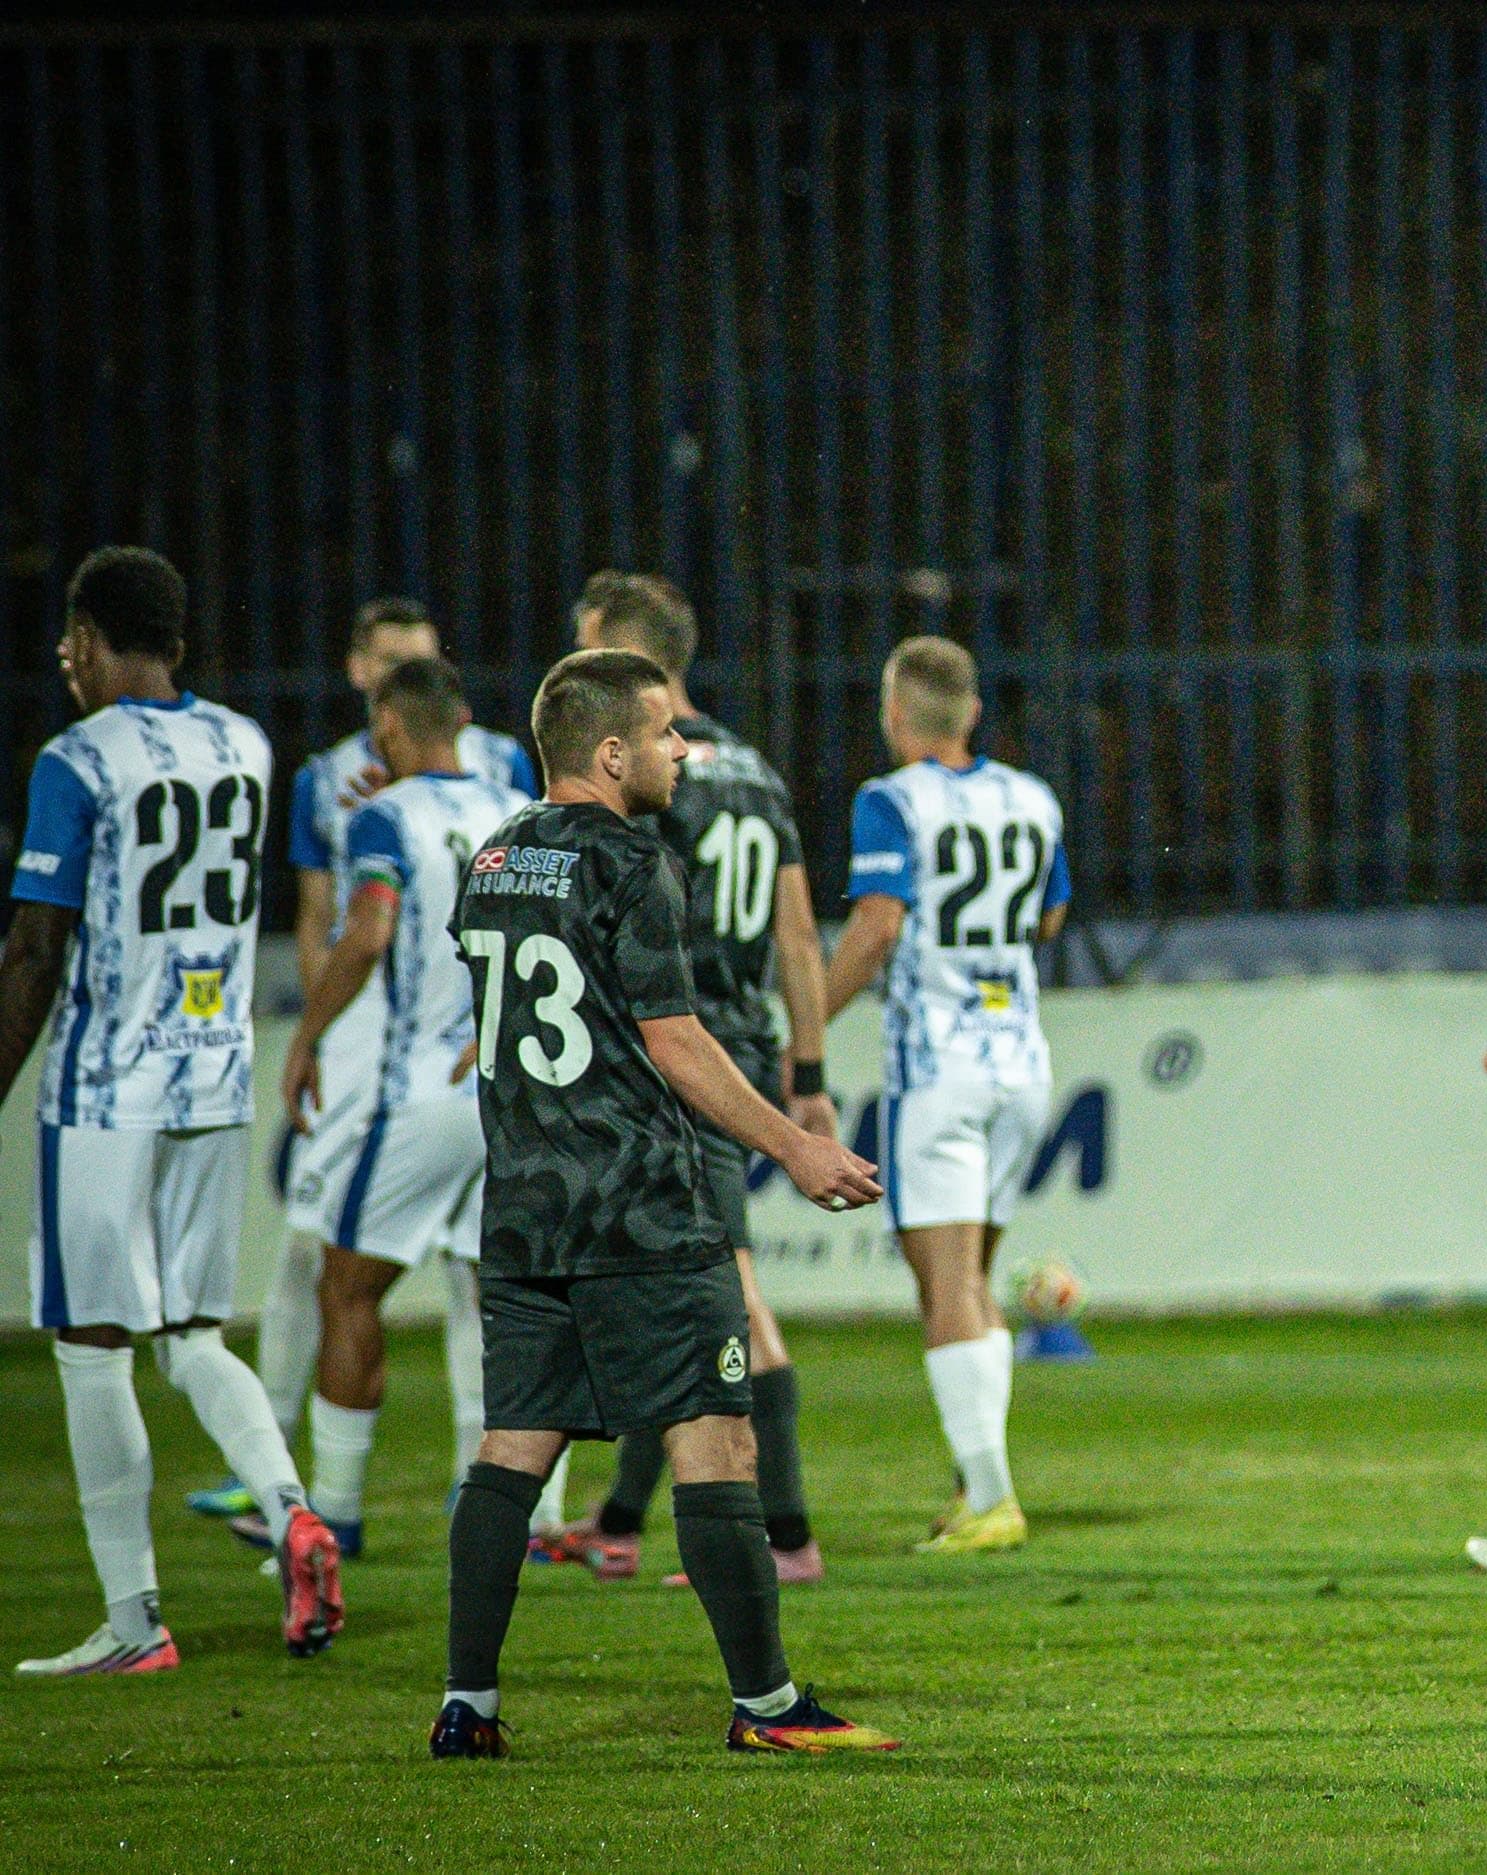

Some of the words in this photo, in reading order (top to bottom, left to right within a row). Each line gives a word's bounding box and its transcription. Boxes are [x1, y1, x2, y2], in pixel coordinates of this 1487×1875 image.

[136, 773, 262, 933] 23
[506, 845, 580, 876] ASSET
[697, 811, 778, 943] 10
[936, 822, 1044, 946] 22
[460, 929, 593, 1087] 73
